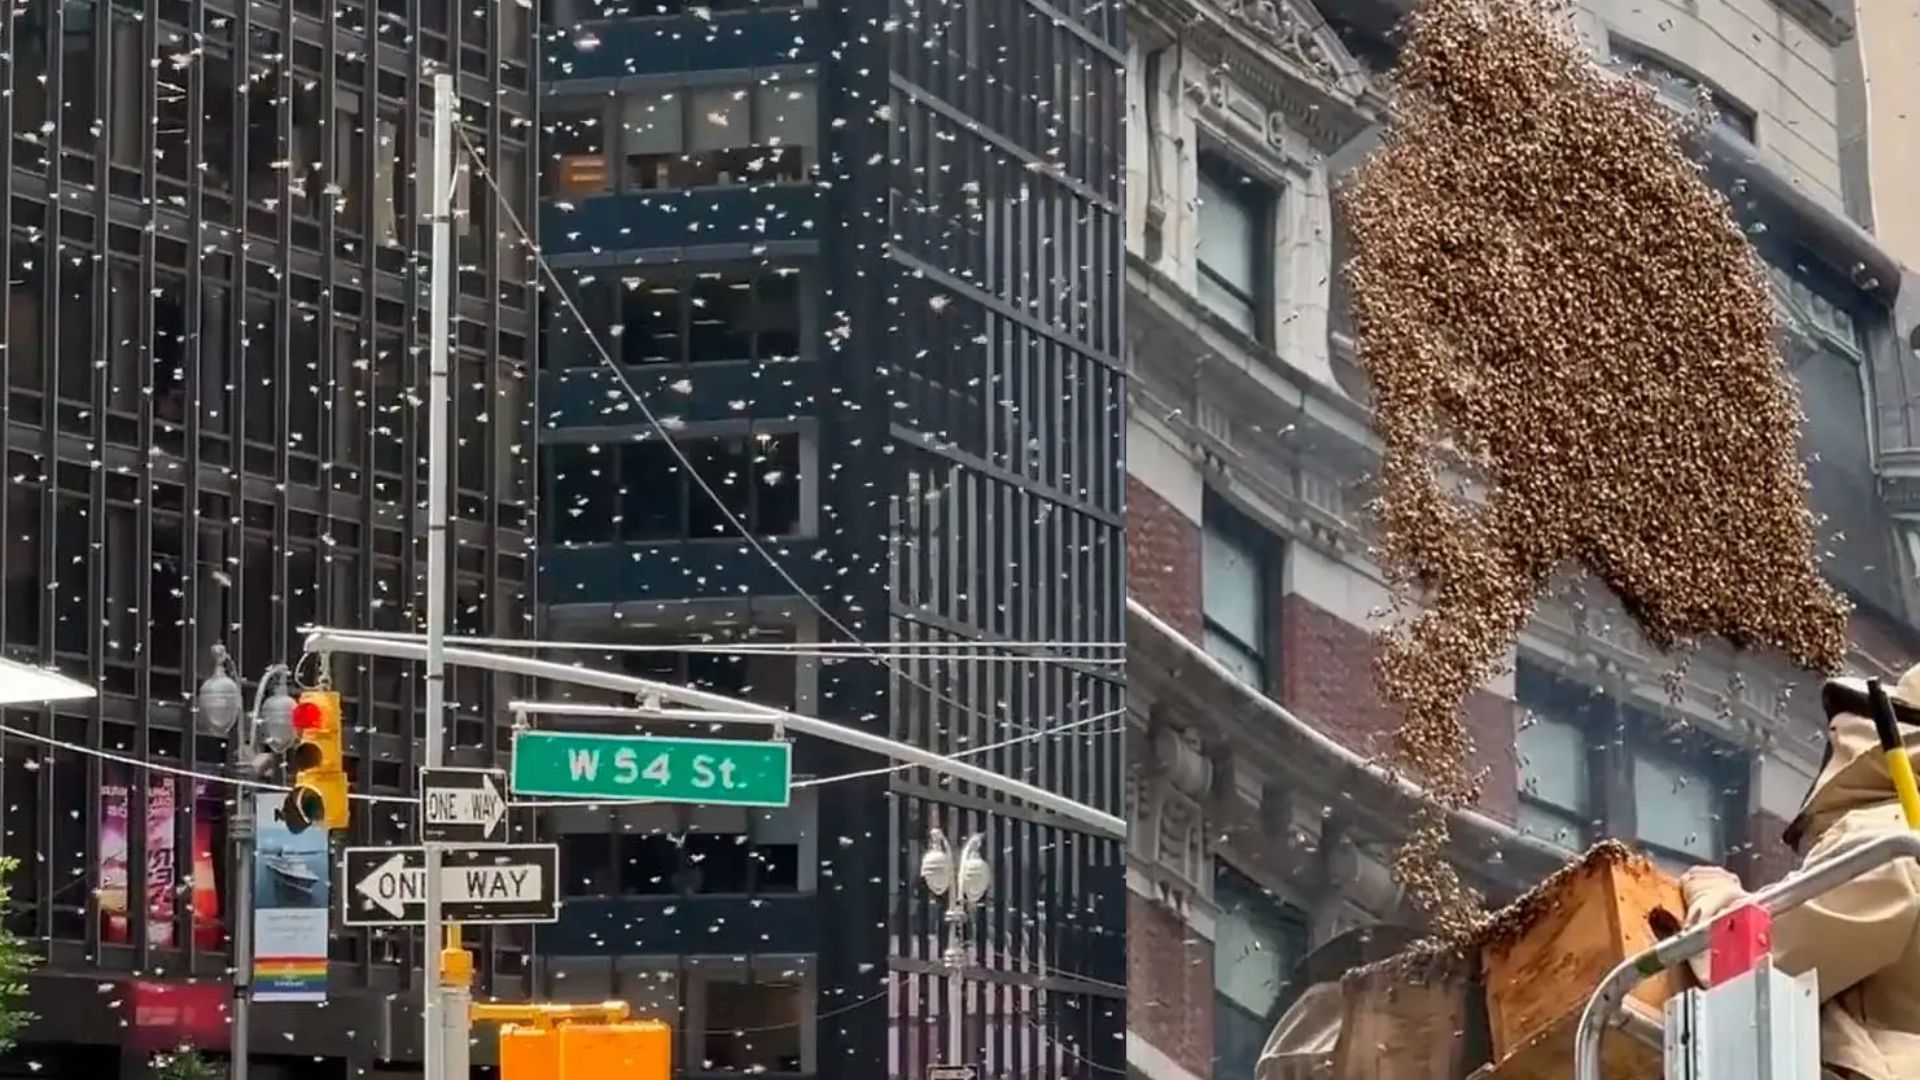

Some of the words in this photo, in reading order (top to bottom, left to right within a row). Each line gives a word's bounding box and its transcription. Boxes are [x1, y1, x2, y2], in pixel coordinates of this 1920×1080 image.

[568, 748, 600, 781] W
[613, 747, 671, 786] 54
[429, 793, 457, 819] ONE
[471, 792, 498, 820] WAY
[466, 869, 528, 898] WAY
